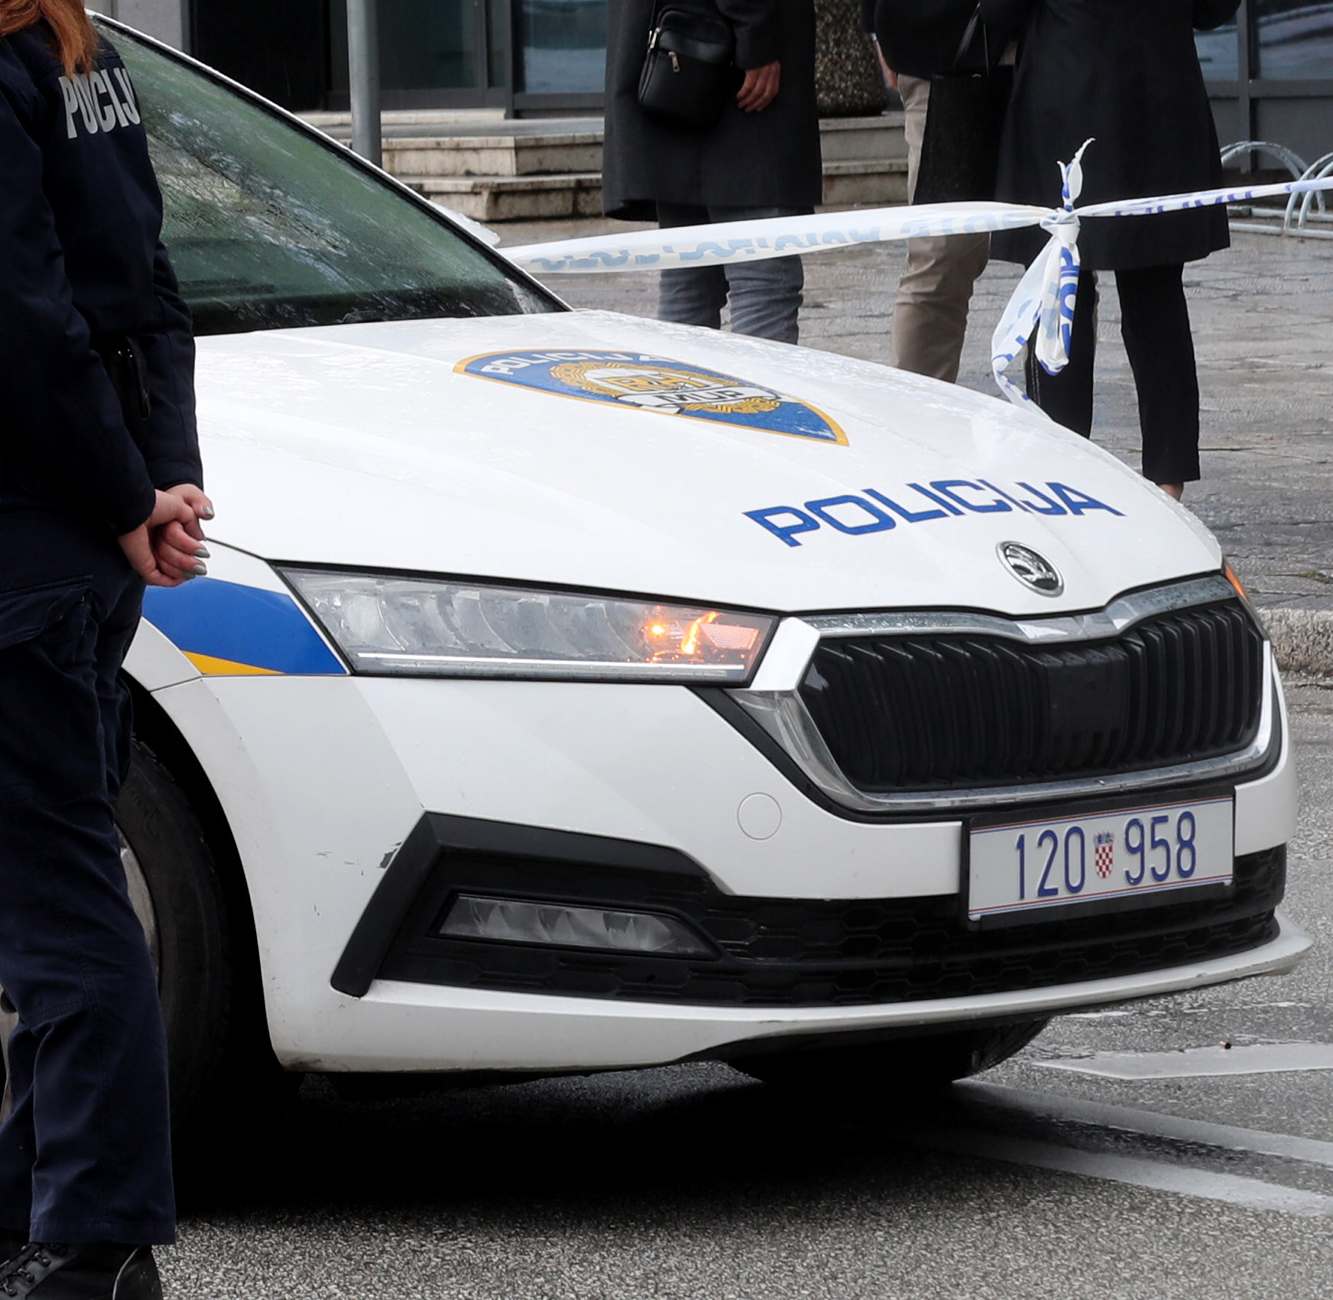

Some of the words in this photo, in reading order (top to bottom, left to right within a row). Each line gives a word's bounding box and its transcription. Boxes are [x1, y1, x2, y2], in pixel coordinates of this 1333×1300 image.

[481, 350, 679, 375] POLICIJA
[653, 387, 747, 404] MUP
[742, 478, 1127, 547] POLICIJA
[1016, 826, 1085, 900] 120
[1124, 810, 1197, 886] 958
